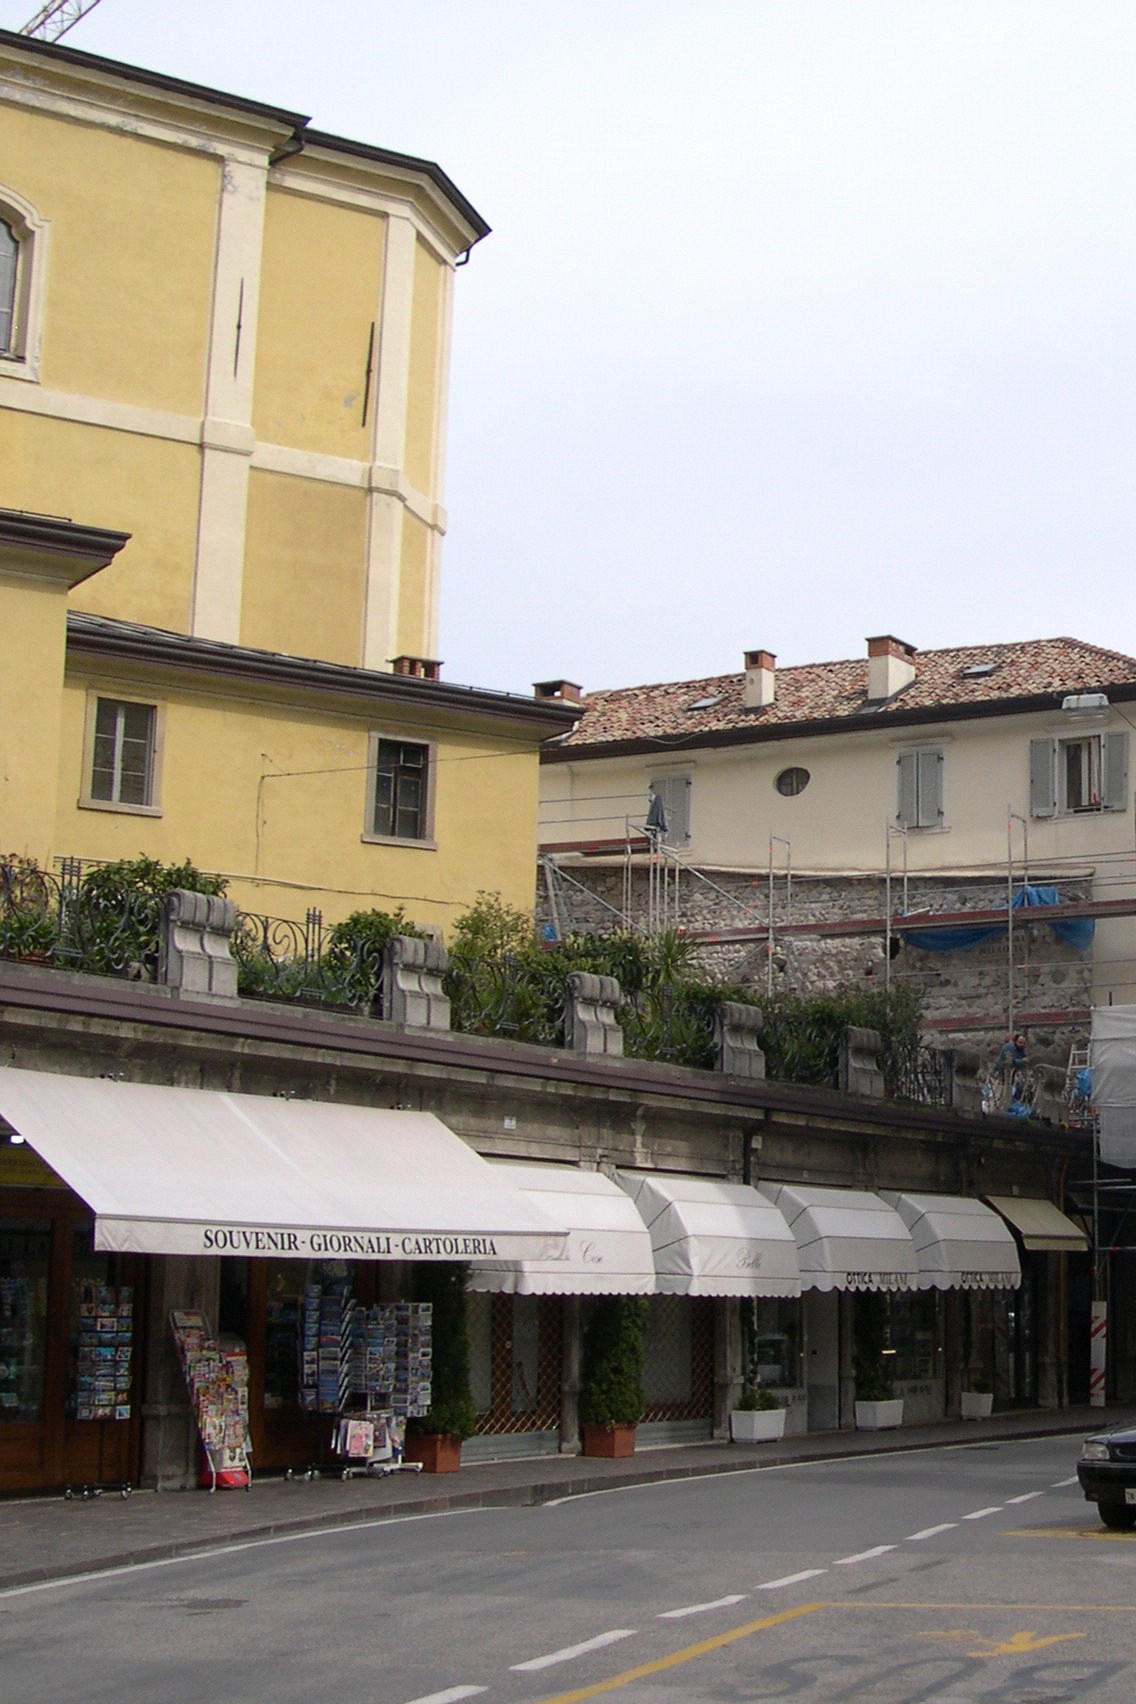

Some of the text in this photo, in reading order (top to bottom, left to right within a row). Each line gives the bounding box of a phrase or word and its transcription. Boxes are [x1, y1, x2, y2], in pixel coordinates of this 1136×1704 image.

[203, 1229, 300, 1251] SOUVENIR
[310, 1233, 391, 1254] GIORNALI
[402, 1236, 498, 1256] CARTOLERIA
[846, 1272, 873, 1284] OTTICA
